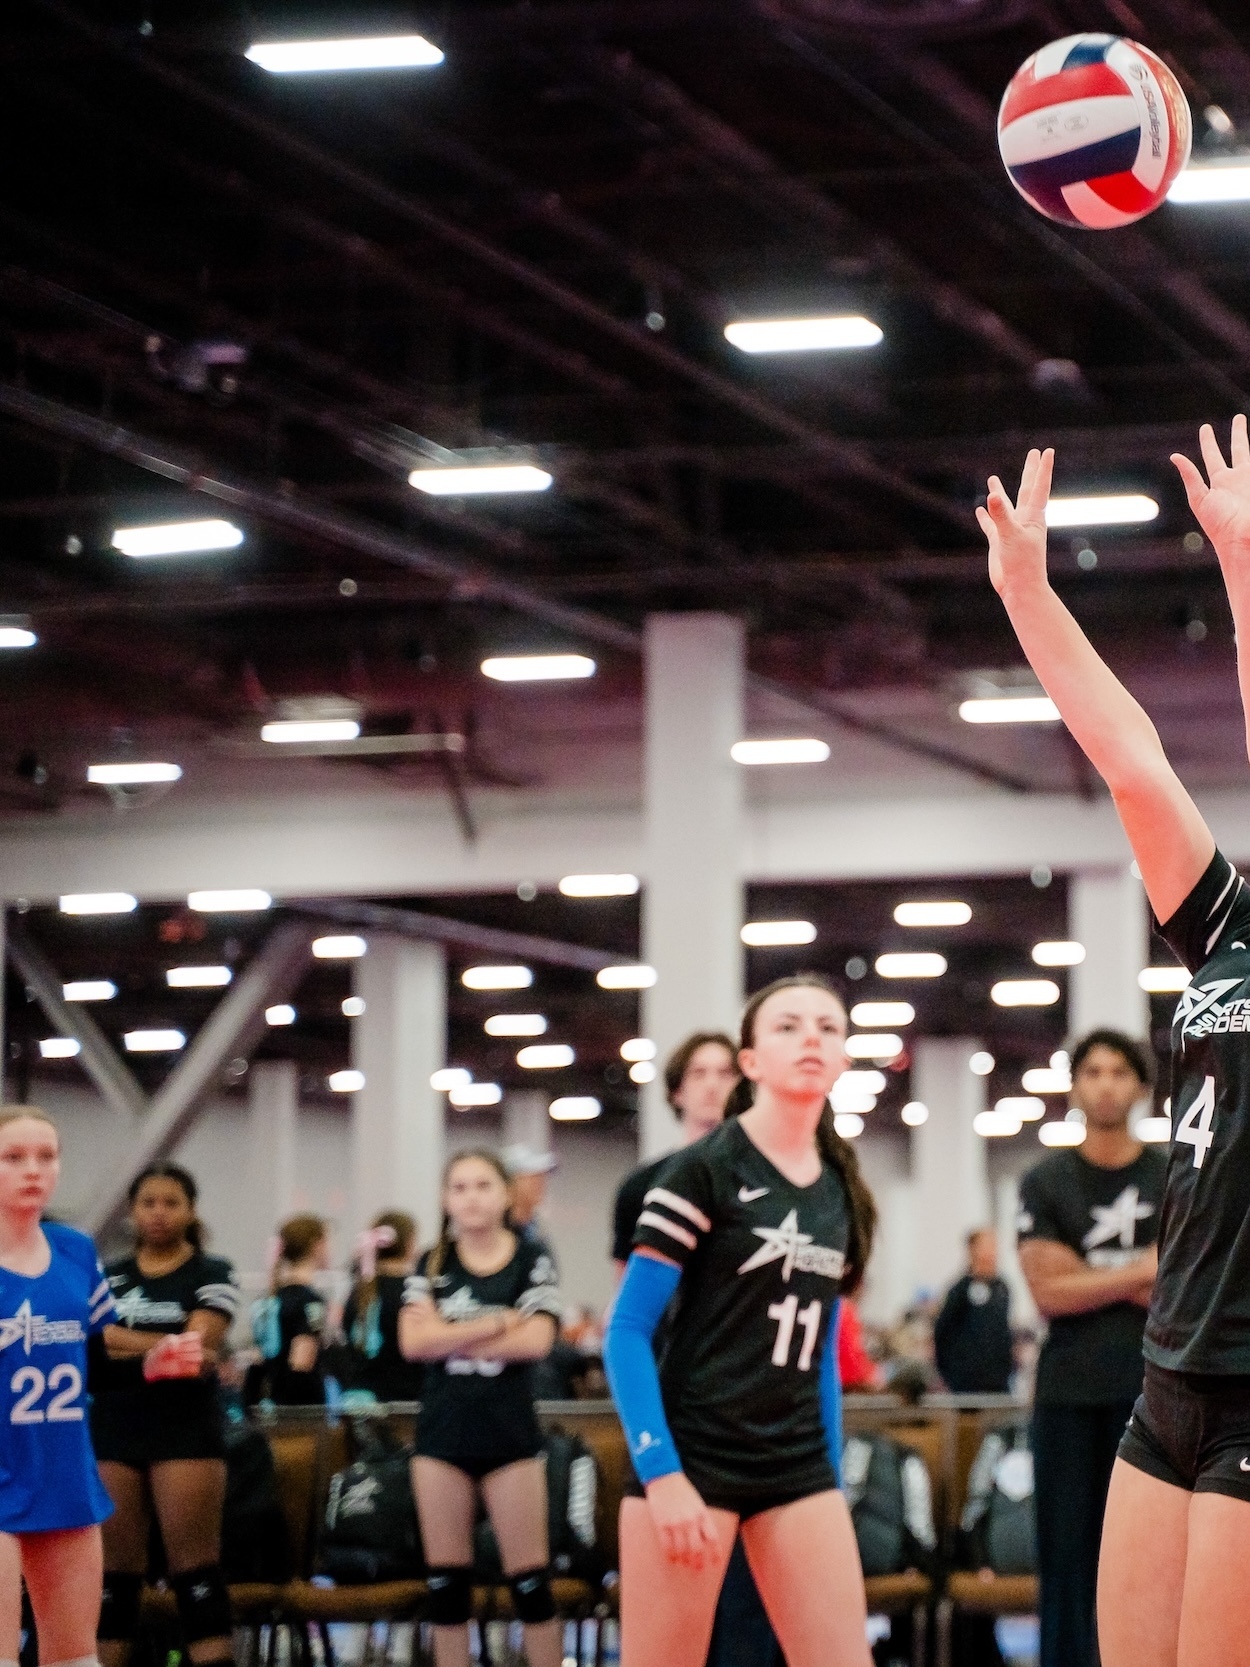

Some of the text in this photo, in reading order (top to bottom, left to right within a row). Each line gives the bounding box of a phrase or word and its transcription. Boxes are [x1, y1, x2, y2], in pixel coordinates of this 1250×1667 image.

[1175, 1075, 1216, 1170] 4
[767, 1294, 823, 1373] 11
[9, 1362, 85, 1426] 22
